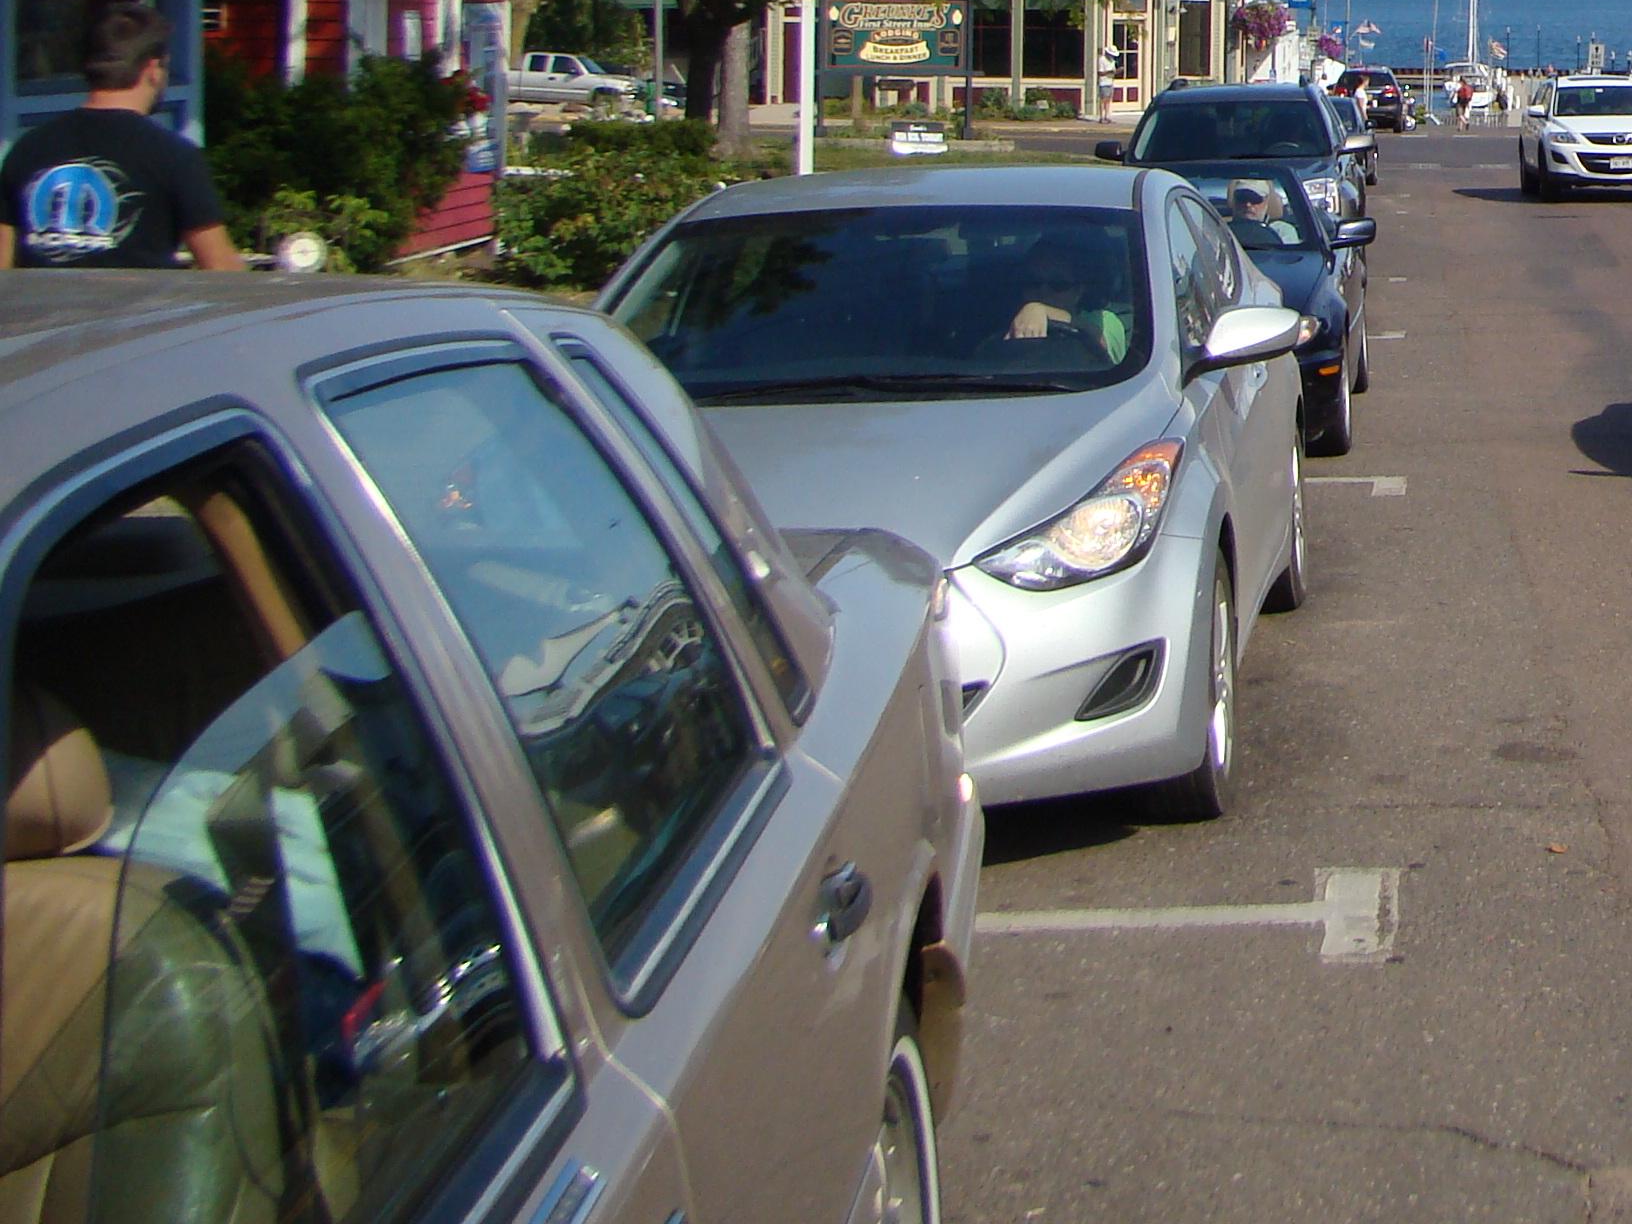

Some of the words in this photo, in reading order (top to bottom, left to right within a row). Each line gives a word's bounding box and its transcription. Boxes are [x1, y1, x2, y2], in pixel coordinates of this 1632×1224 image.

[860, 20, 880, 28] First
[882, 19, 912, 28] Street
[873, 28, 920, 40] LODGING
[872, 44, 919, 54] BREAKFAST
[866, 53, 891, 61] LUNCH
[899, 52, 928, 61] DINNER
